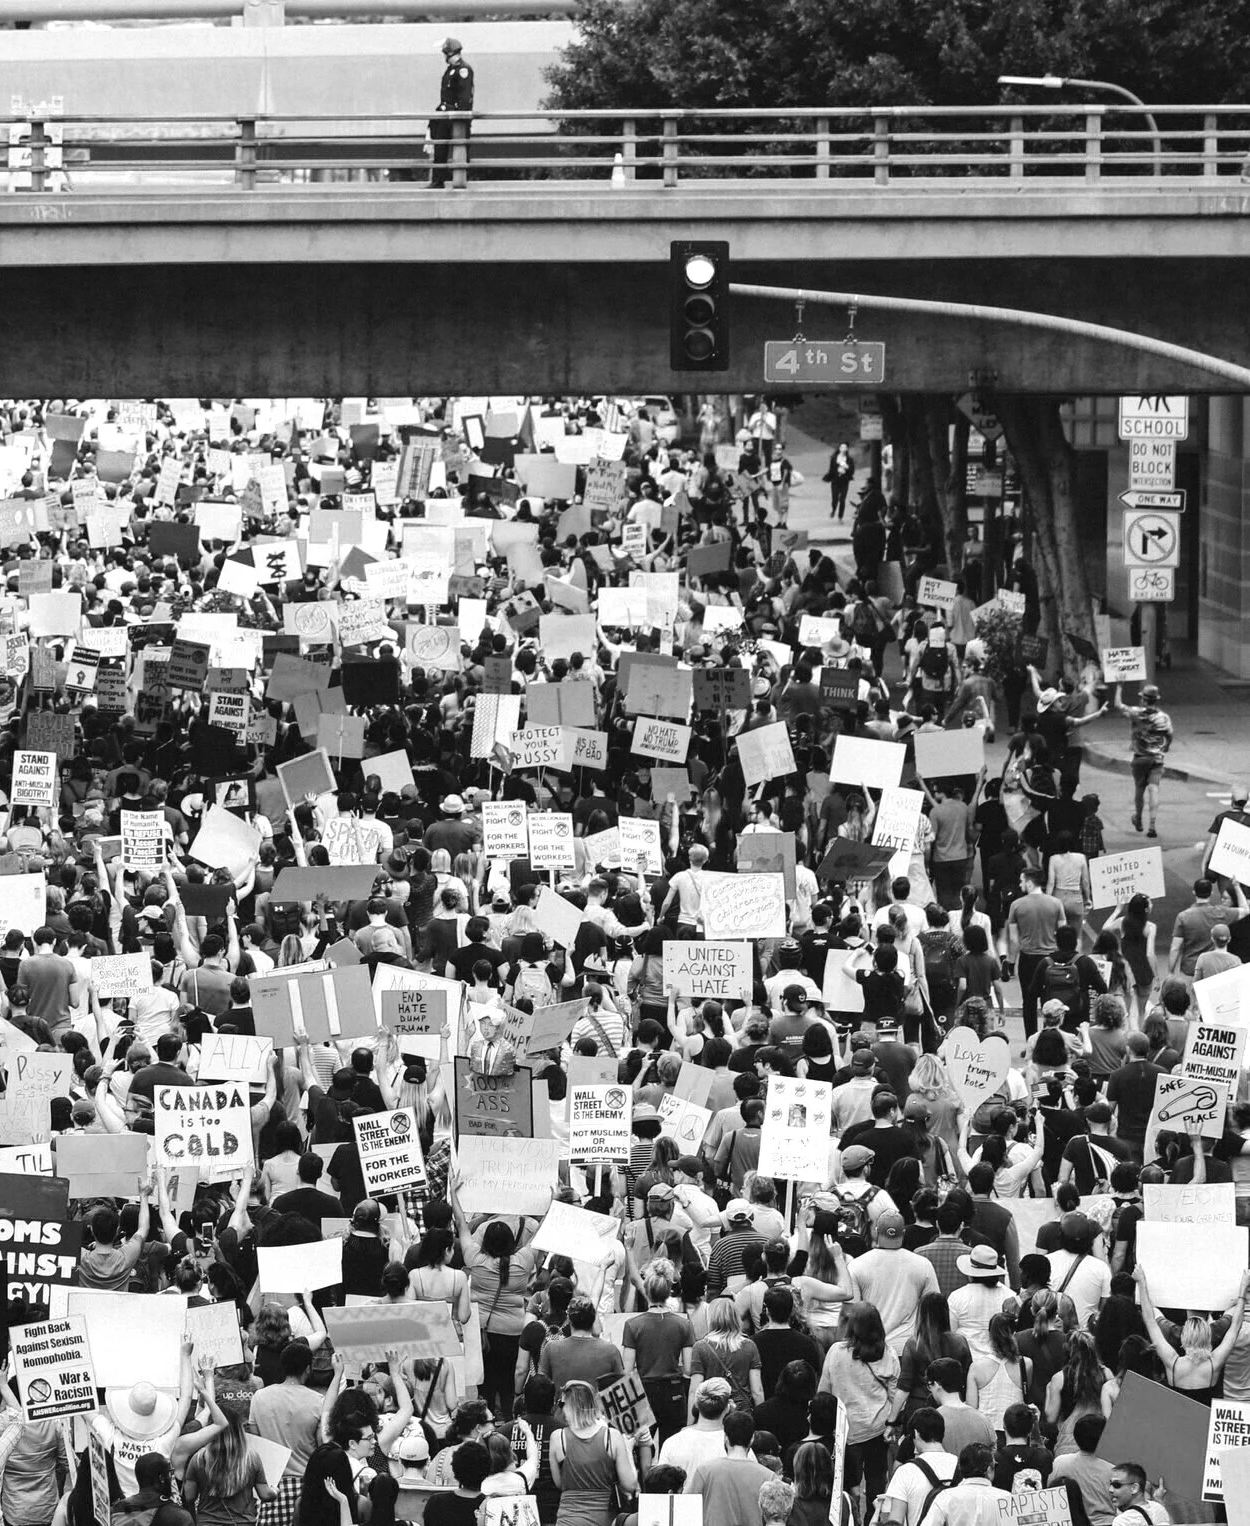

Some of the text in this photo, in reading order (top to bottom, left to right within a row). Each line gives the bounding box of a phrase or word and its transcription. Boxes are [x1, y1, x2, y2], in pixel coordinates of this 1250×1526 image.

[775, 350, 873, 375] 4th St
[1123, 419, 1183, 435] SCHOOL
[1132, 443, 1172, 457] DO NOT
[1132, 461, 1172, 474] BLOCK
[1137, 494, 1179, 506] ONE WAY
[822, 686, 855, 698] THINK
[217, 695, 244, 706] STAND
[213, 706, 245, 717] AGAINST
[511, 727, 561, 742] PROTECT
[648, 725, 679, 738] NO HATE
[524, 741, 550, 750] YOUR
[642, 733, 679, 747] NO TRUMP
[21, 753, 50, 765] STAND
[514, 749, 559, 766] PUSSY
[585, 749, 602, 760] BAD
[18, 765, 51, 776] AGAINST
[14, 780, 52, 790] ANTI-MUSLIM
[16, 789, 49, 800] BIGOTRY!
[141, 812, 159, 820] Name
[485, 818, 507, 826] FIGHT
[486, 832, 518, 841] FOR THE
[532, 829, 553, 837] FIGHT
[487, 842, 526, 851] WORKERS
[533, 844, 565, 853] FOR THE
[875, 831, 910, 852] HATE
[533, 854, 572, 862] WORKERS
[1106, 861, 1140, 875] UNITED
[1113, 883, 1137, 896] HATE
[687, 948, 736, 963] UNITED
[677, 964, 738, 978] AGAINST
[691, 979, 731, 995] HATE
[402, 992, 423, 1003] END
[398, 1003, 428, 1014] HATE
[399, 1015, 427, 1023] DUMP
[394, 1024, 431, 1033] TRUMP
[1196, 1026, 1236, 1045] STAND
[208, 1037, 273, 1071] ALLY
[1191, 1041, 1237, 1061] AGAINST
[967, 1063, 997, 1082] trumps
[1184, 1062, 1238, 1081] ANTI-MUSLIM
[964, 1074, 986, 1090] hate
[1159, 1077, 1186, 1096] SAFE
[159, 1088, 245, 1112] CANADA
[575, 1091, 597, 1102] WALL
[476, 1095, 511, 1113] ASS
[574, 1100, 604, 1111] STREET
[179, 1115, 220, 1128] is too
[573, 1109, 626, 1120] IS THE ENEMY.
[1182, 1109, 1218, 1125] PLACE
[358, 1120, 382, 1133] WALL
[468, 1120, 484, 1129] BAD
[360, 1128, 390, 1142] STREET
[572, 1129, 629, 1138] NOT MUSLIMS
[162, 1131, 239, 1159] COLD
[362, 1134, 415, 1153] IS THE ENEMY.
[592, 1138, 606, 1146] OR
[571, 1146, 628, 1155] IMMIGRANTS
[365, 1153, 411, 1172] FOR THE
[367, 1165, 422, 1185] WORKERS
[24, 1320, 71, 1339] Fight Back
[16, 1333, 85, 1356] Against Sexism,
[22, 1349, 83, 1369] Homophobia,
[59, 1371, 90, 1386] War &
[54, 1385, 93, 1402] Racism
[222, 1390, 234, 1401] up
[601, 1377, 647, 1419] HELL
[1215, 1407, 1245, 1422] WALL
[1212, 1432, 1239, 1447] IS THE
[997, 1485, 1069, 1520] RAPISTS
